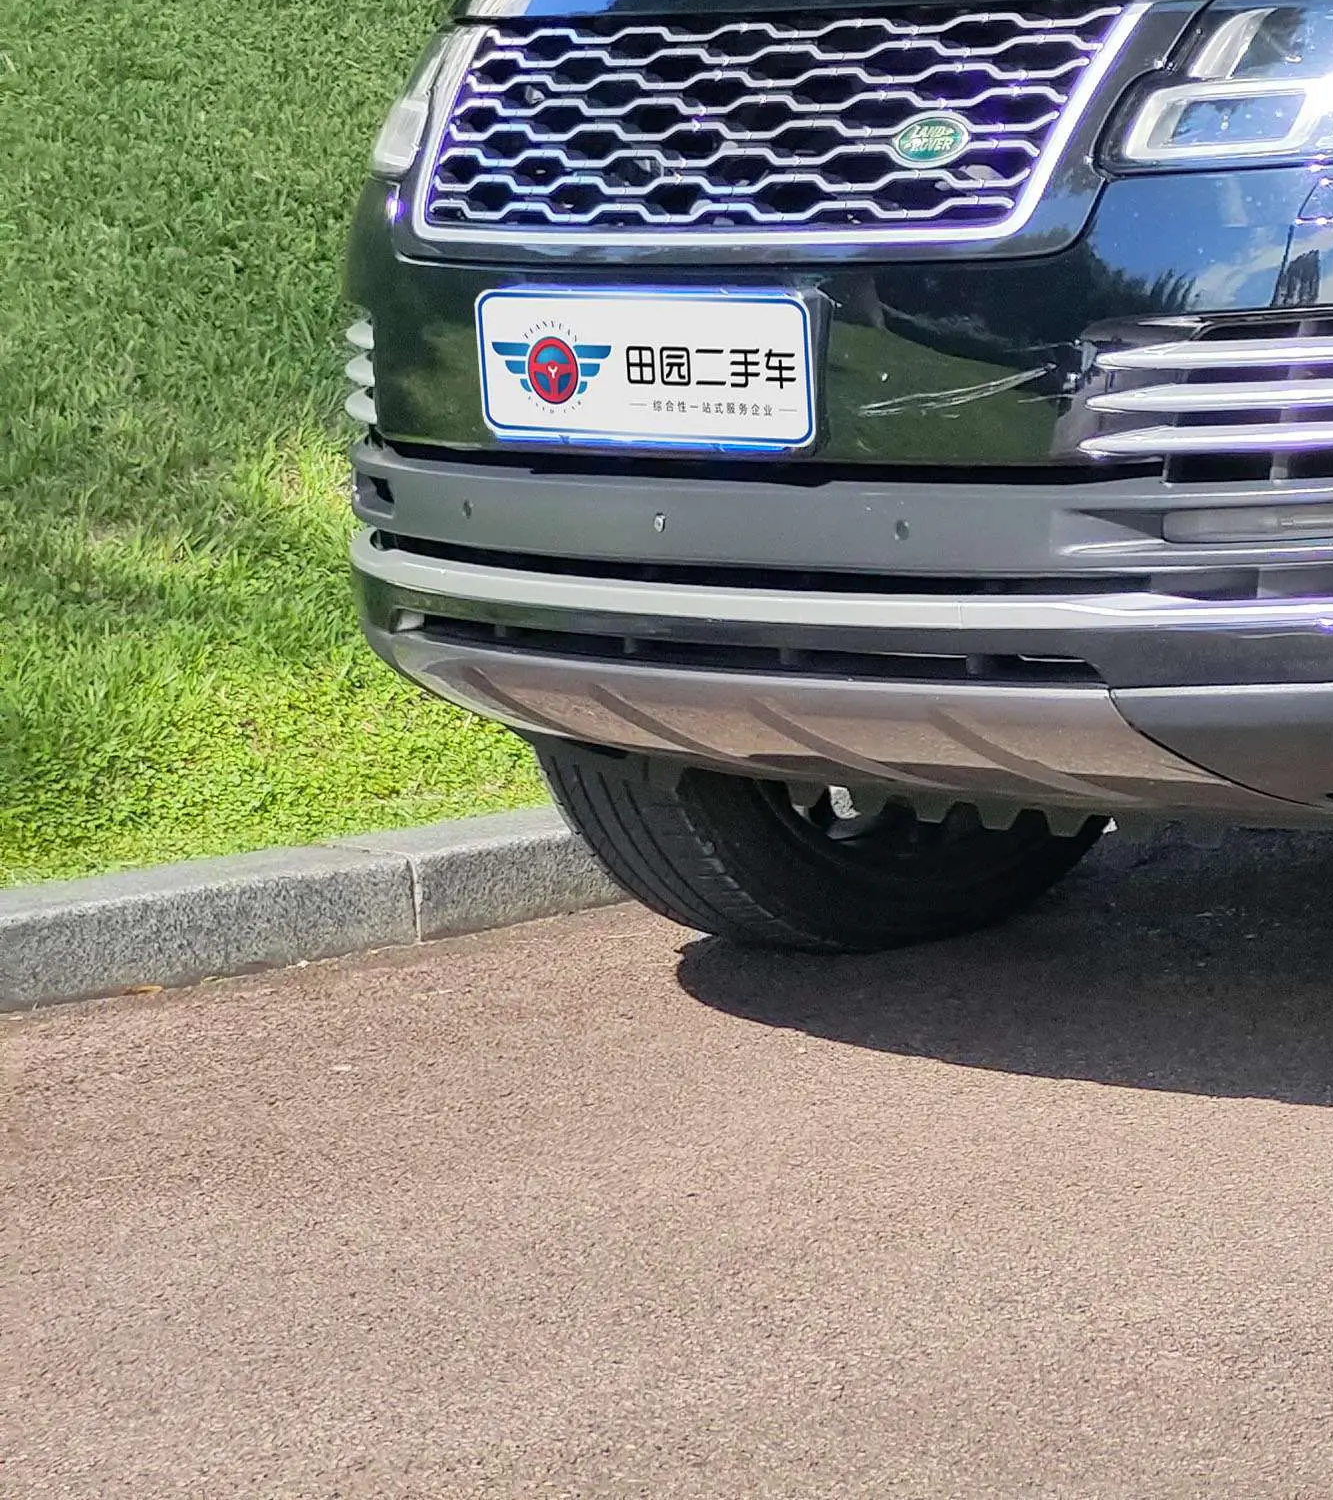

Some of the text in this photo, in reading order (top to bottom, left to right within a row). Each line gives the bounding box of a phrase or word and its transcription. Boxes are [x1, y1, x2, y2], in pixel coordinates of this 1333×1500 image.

[626, 345, 797, 390] 田园二手车
[652, 399, 773, 417] 综合性一站式服务企业
